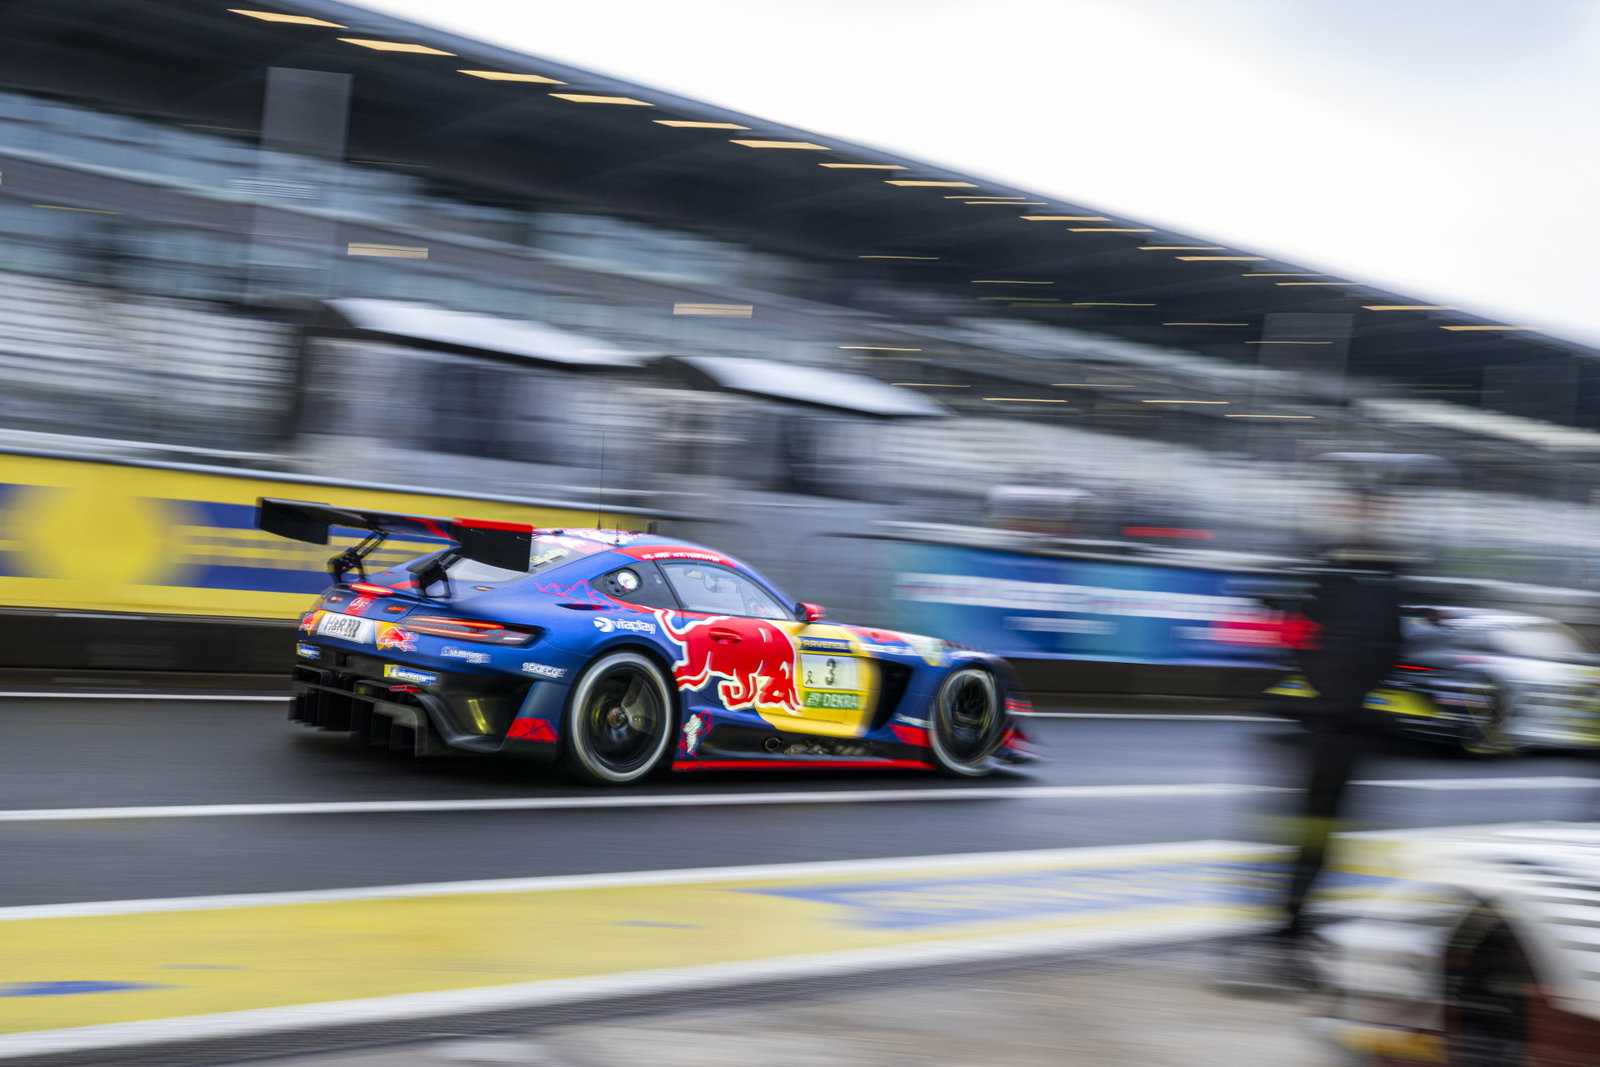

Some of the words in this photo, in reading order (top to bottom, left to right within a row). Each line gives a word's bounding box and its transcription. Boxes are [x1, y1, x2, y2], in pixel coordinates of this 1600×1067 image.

[612, 618, 656, 635] viaplay
[522, 662, 566, 678] sparco
[825, 658, 836, 686] 3
[823, 693, 858, 709] DEKRA
